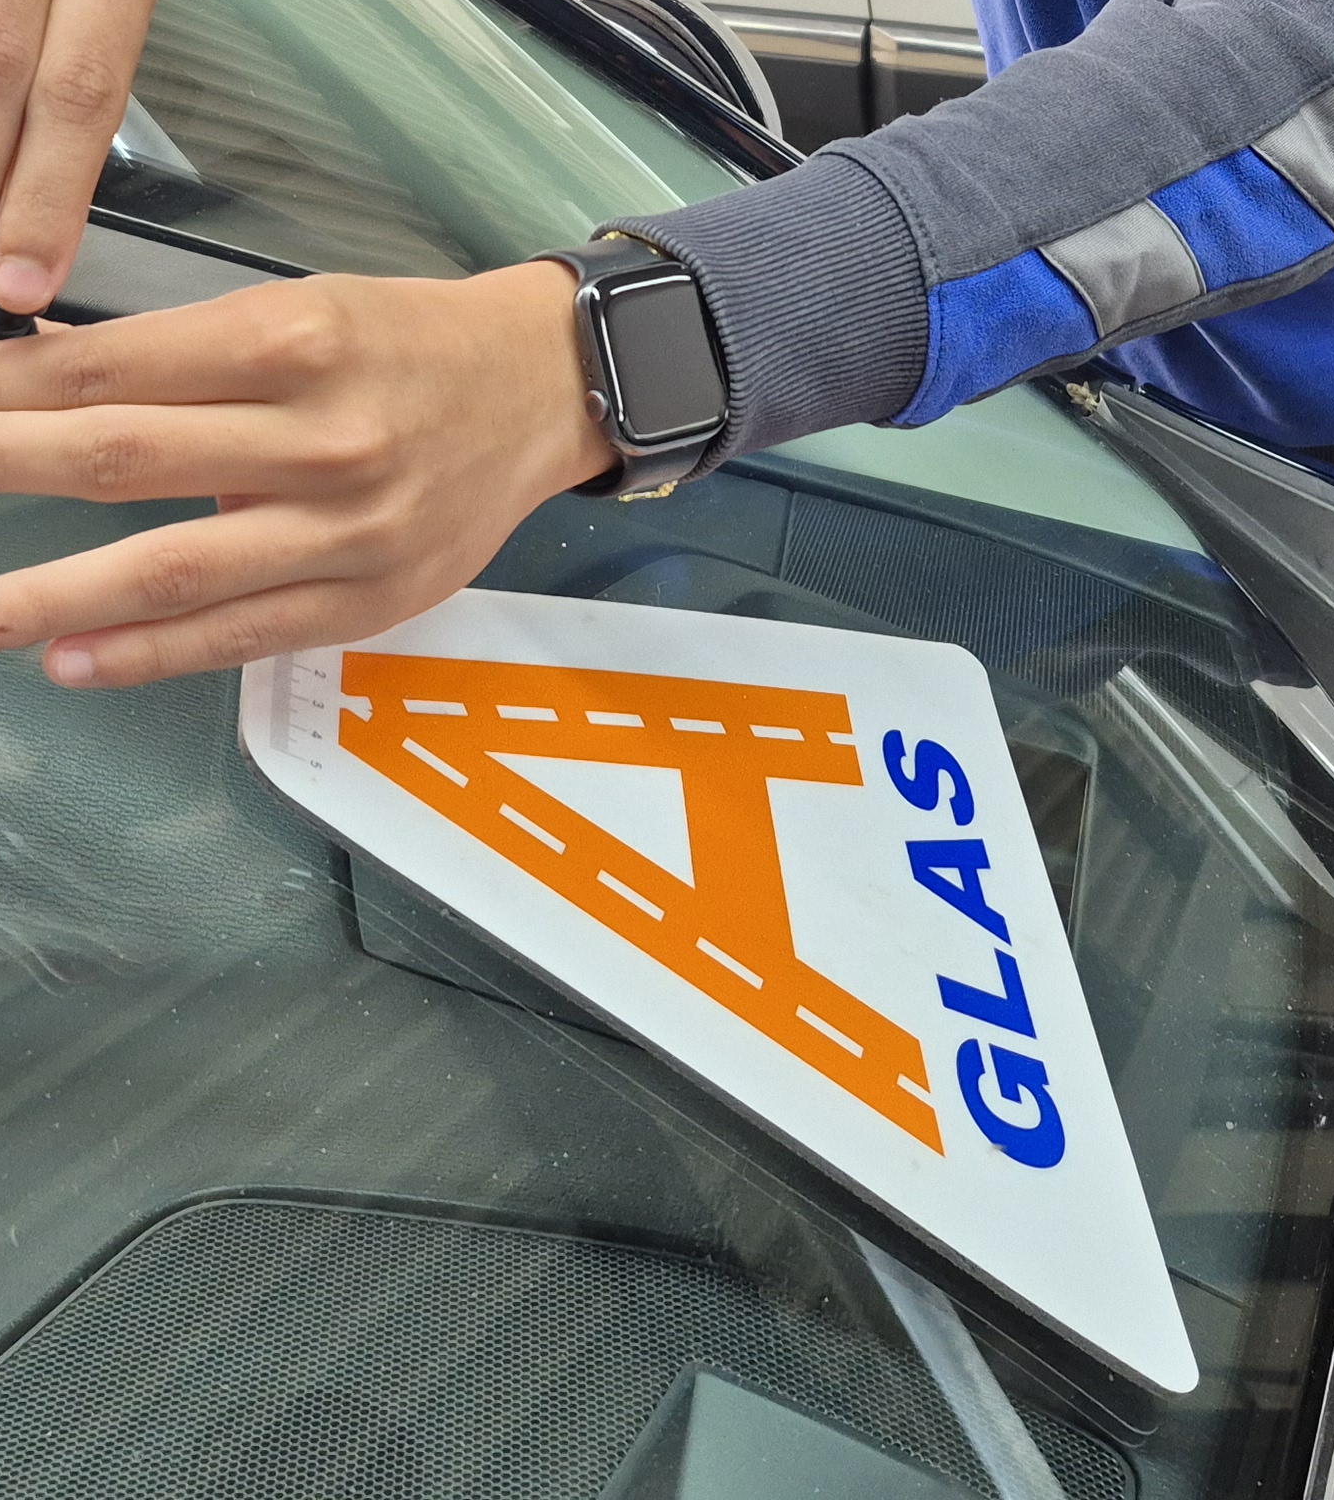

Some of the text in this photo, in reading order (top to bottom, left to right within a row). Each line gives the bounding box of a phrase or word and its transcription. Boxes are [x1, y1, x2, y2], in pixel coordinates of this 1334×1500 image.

[314, 669, 327, 679] 2
[312, 699, 325, 710] 3
[310, 730, 323, 740] 4
[310, 760, 323, 770] 5
[882, 729, 1066, 1169] GLAS
